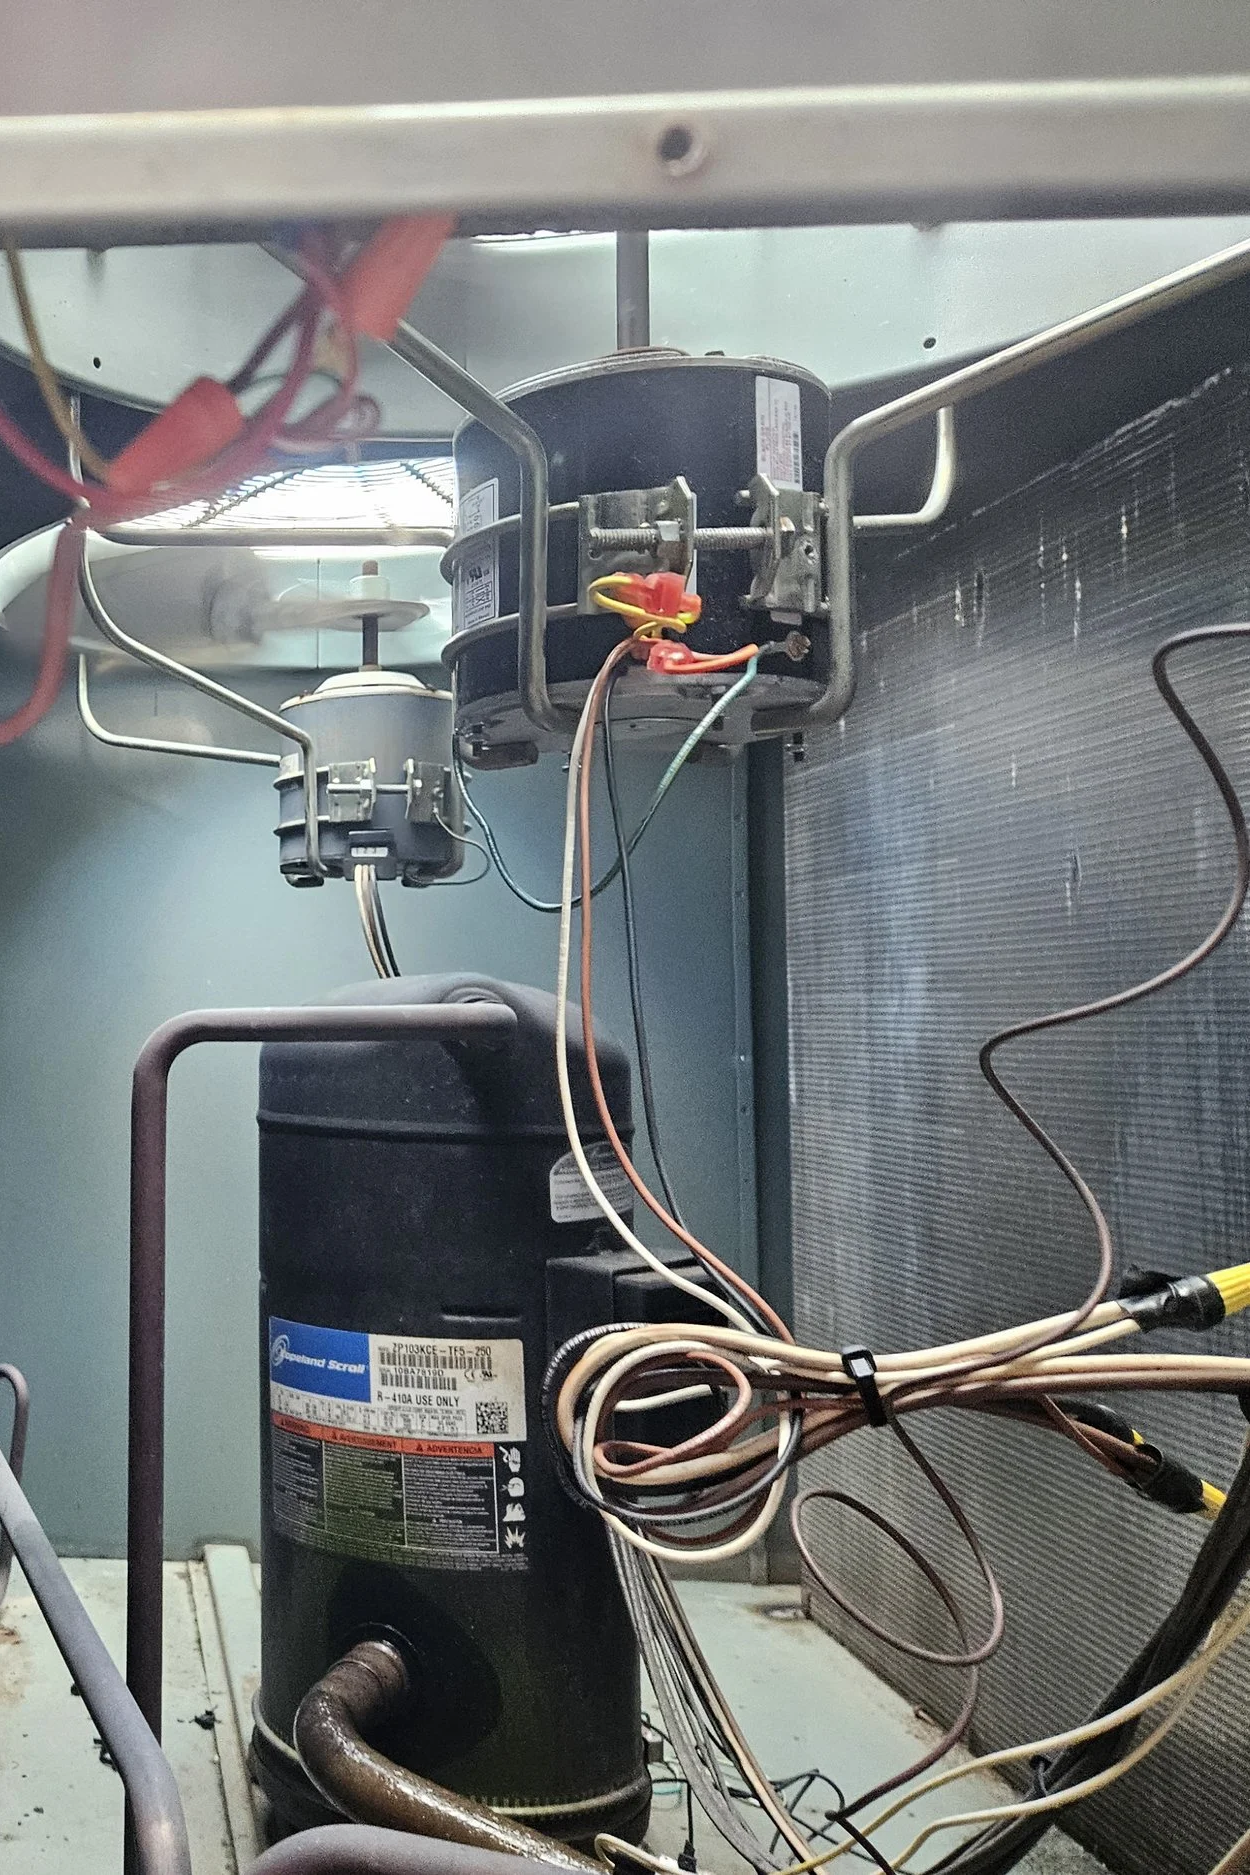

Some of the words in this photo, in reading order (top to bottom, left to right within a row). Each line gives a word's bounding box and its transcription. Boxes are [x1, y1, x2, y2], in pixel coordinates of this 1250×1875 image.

[327, 1359, 366, 1374] Scroll
[377, 1390, 413, 1405] R-410A
[416, 1394, 433, 1406] USE
[436, 1395, 460, 1407] ONLY
